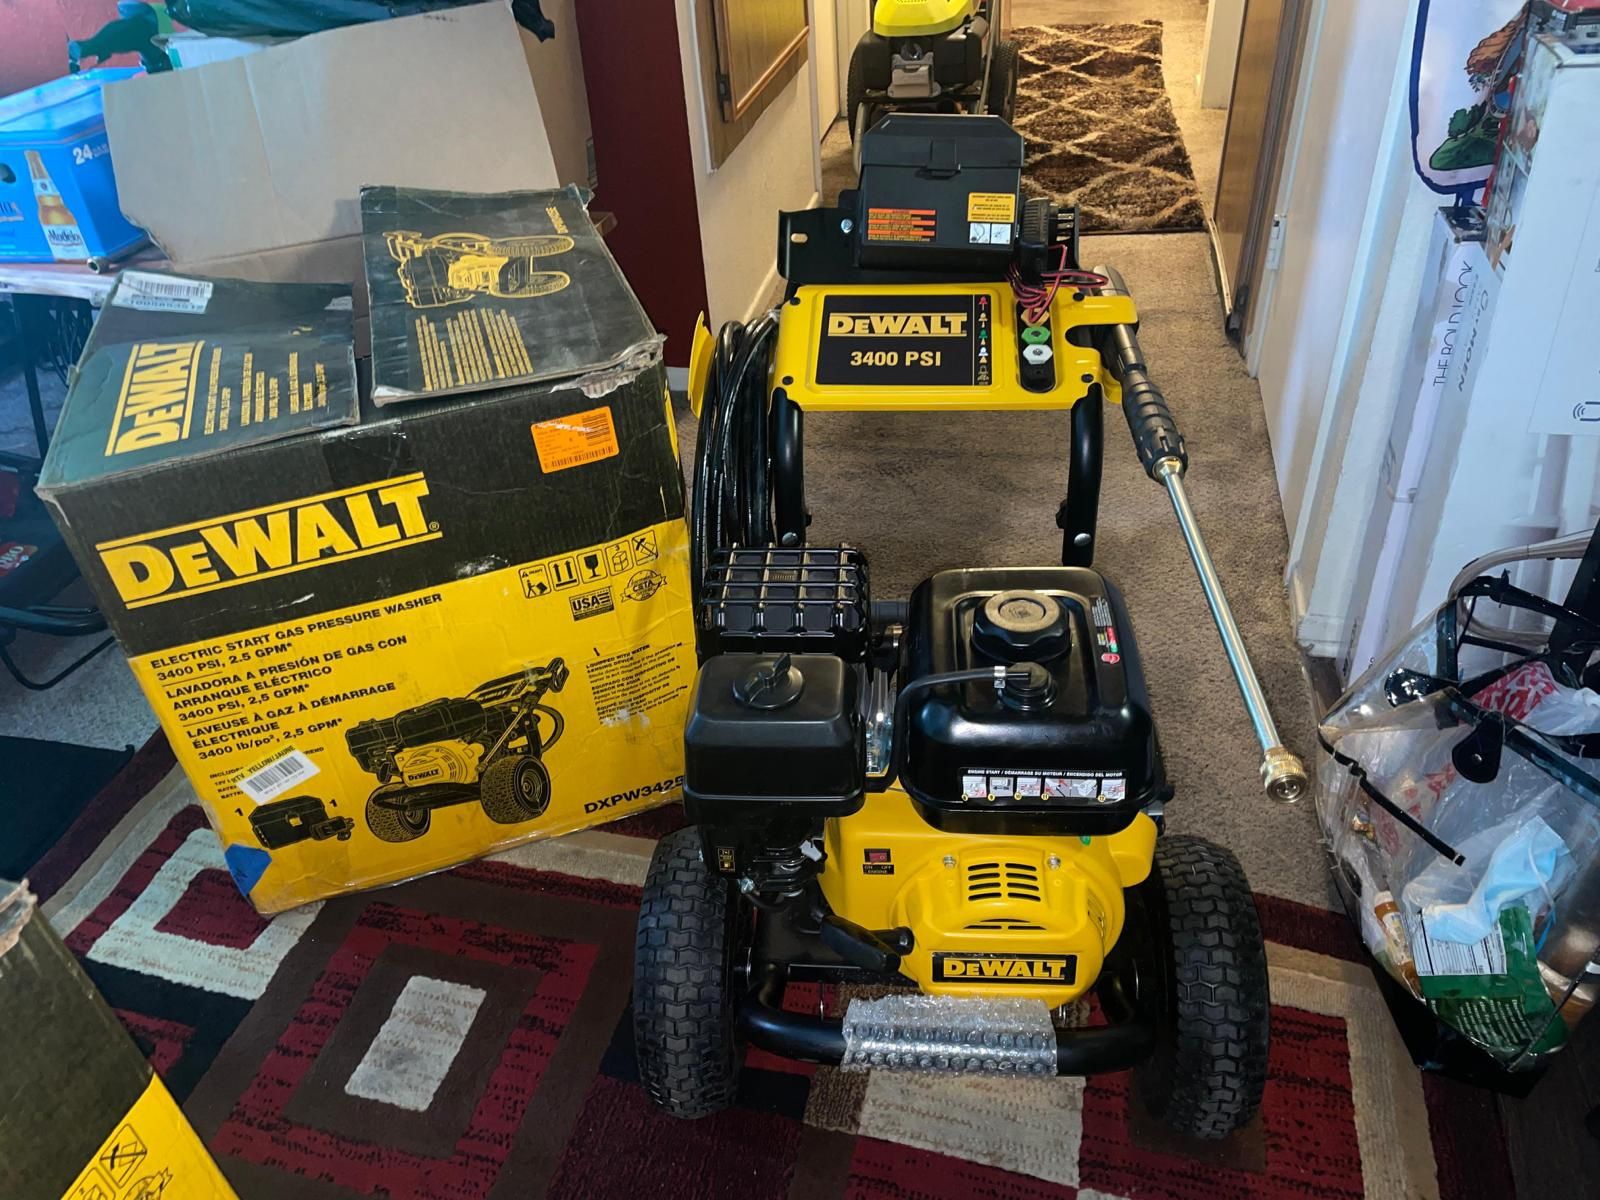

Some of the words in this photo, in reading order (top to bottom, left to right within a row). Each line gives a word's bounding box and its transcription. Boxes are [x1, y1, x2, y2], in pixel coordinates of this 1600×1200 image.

[73, 144, 93, 165] 24
[828, 316, 967, 335] DEWALT
[850, 351, 898, 367] 3400
[905, 351, 941, 367] PSI
[115, 342, 196, 455] DEWALT
[99, 479, 430, 603] DEWALT
[572, 596, 600, 611] USA
[151, 645, 223, 670] ELECTRIC
[226, 634, 271, 652] START
[275, 626, 305, 640] GAS
[307, 608, 381, 633] PRESSURE
[384, 593, 442, 615] WASHER
[157, 664, 194, 681] 3400
[197, 658, 225, 672] PSI,
[229, 651, 251, 664] 2.5
[166, 674, 241, 699] LAVADORA
[246, 671, 255, 681] A
[259, 655, 320, 677] PRESIÓN
[324, 650, 343, 663] DE
[347, 643, 375, 657] GAS
[377, 635, 407, 650] CON
[173, 684, 251, 710] ARRANQUE
[255, 666, 332, 692] ELÉCTRICO
[179, 706, 214, 722] 3400
[218, 700, 245, 713] PSI,
[248, 693, 270, 707] 2,5
[187, 716, 251, 739] LAVEUSE
[254, 709, 262, 722] À
[266, 704, 295, 720] GAZ
[298, 699, 308, 712] À
[311, 682, 396, 709] DÉMARRAGE
[192, 721, 280, 750] ÉLECTRIQUE
[199, 745, 233, 761] 3400
[283, 727, 304, 740] 2,5
[235, 808, 243, 816] 1
[330, 799, 337, 807] 1
[943, 960, 1067, 978] DEWALT
